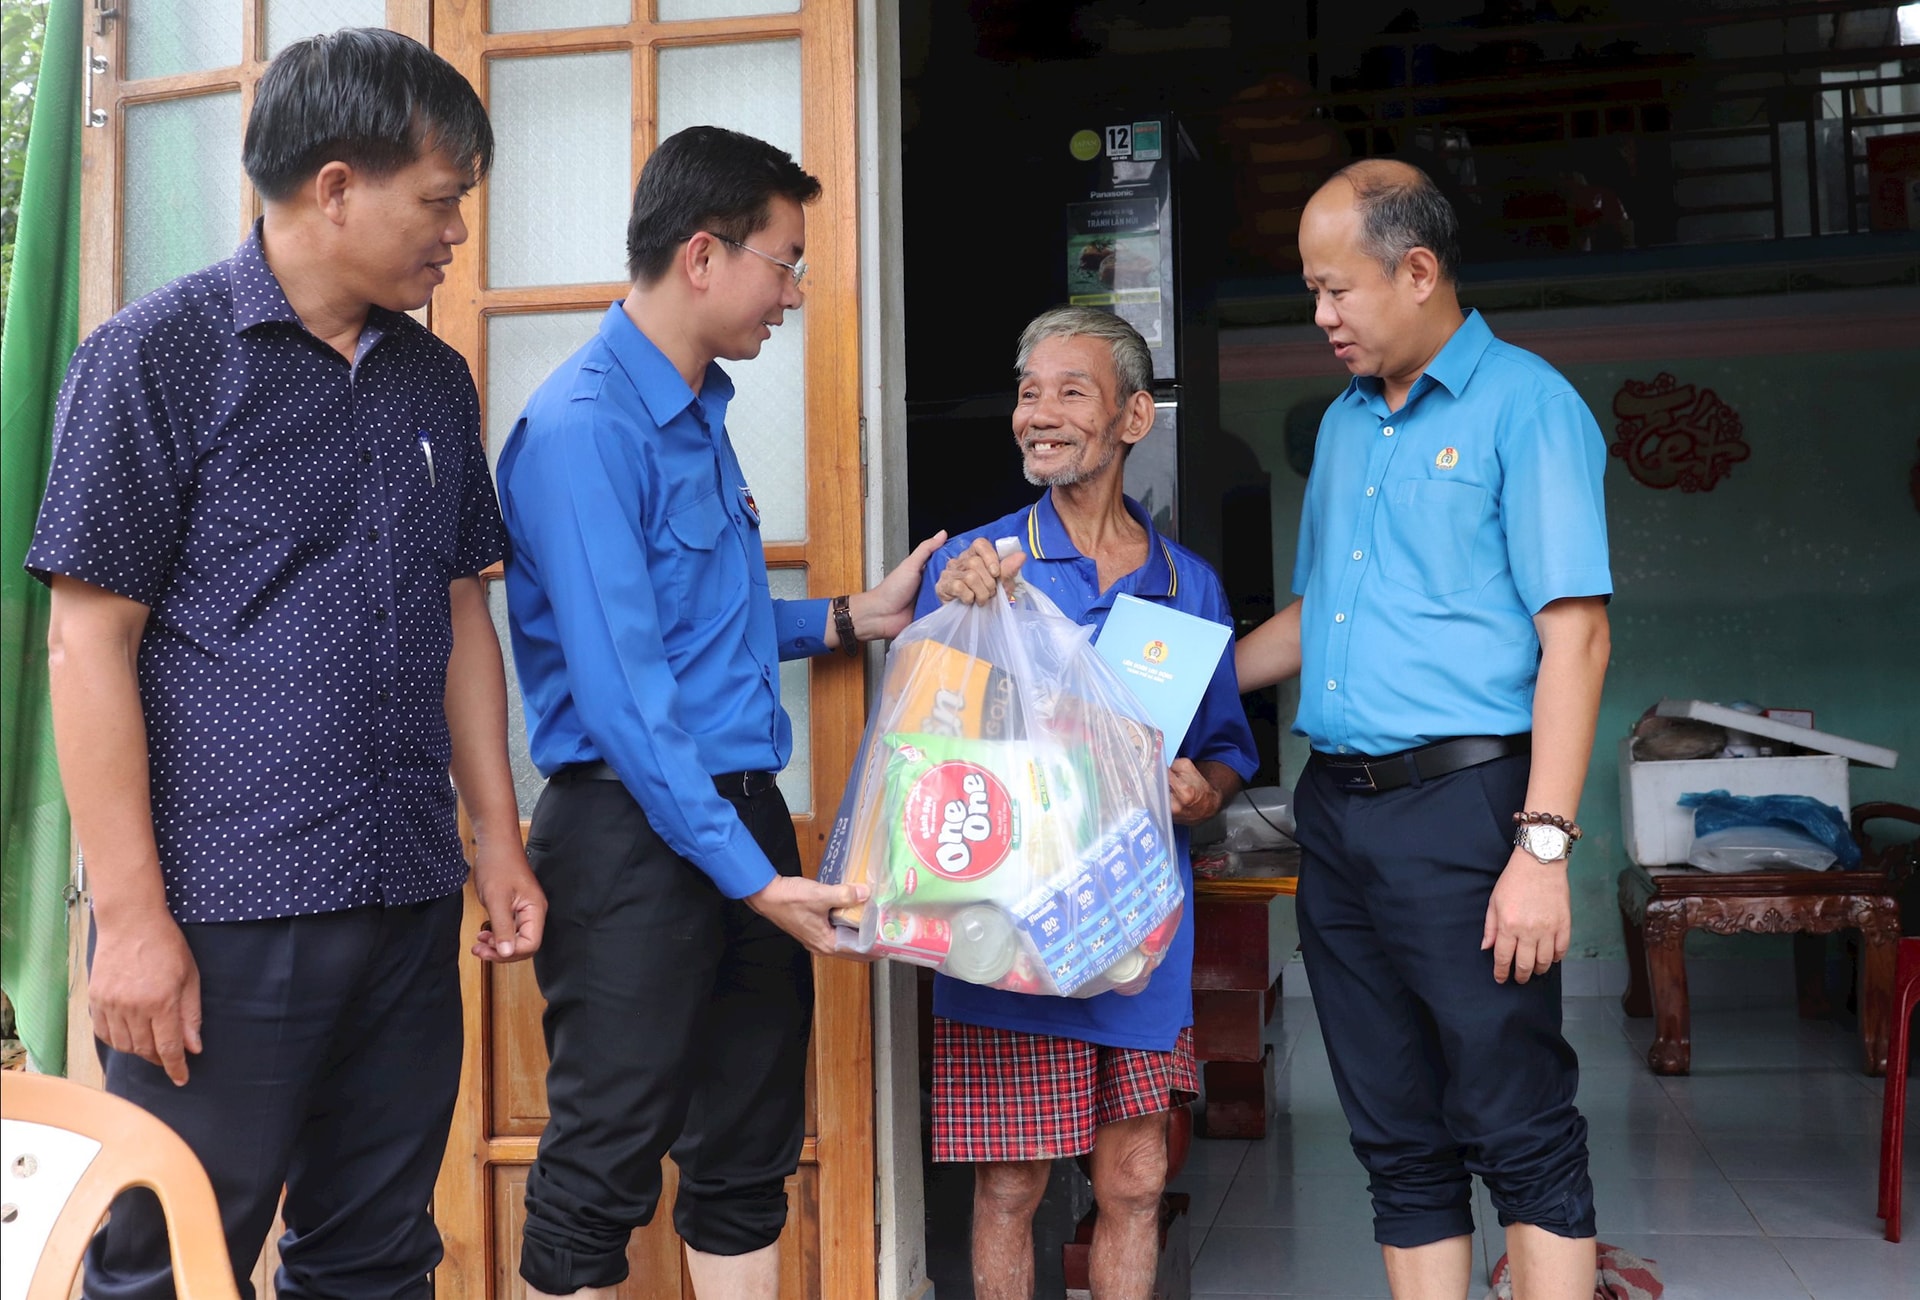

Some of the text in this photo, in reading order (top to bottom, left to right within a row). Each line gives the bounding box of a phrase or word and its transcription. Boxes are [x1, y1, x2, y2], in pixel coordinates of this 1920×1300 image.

[1108, 128, 1129, 150] 12
[1090, 189, 1134, 199] Panasonic
[985, 678, 1013, 736] GOLD
[962, 773, 991, 842] One
[935, 799, 971, 873] One
[1129, 817, 1150, 839] Vinamilk
[1027, 899, 1056, 924] Vinamilk
